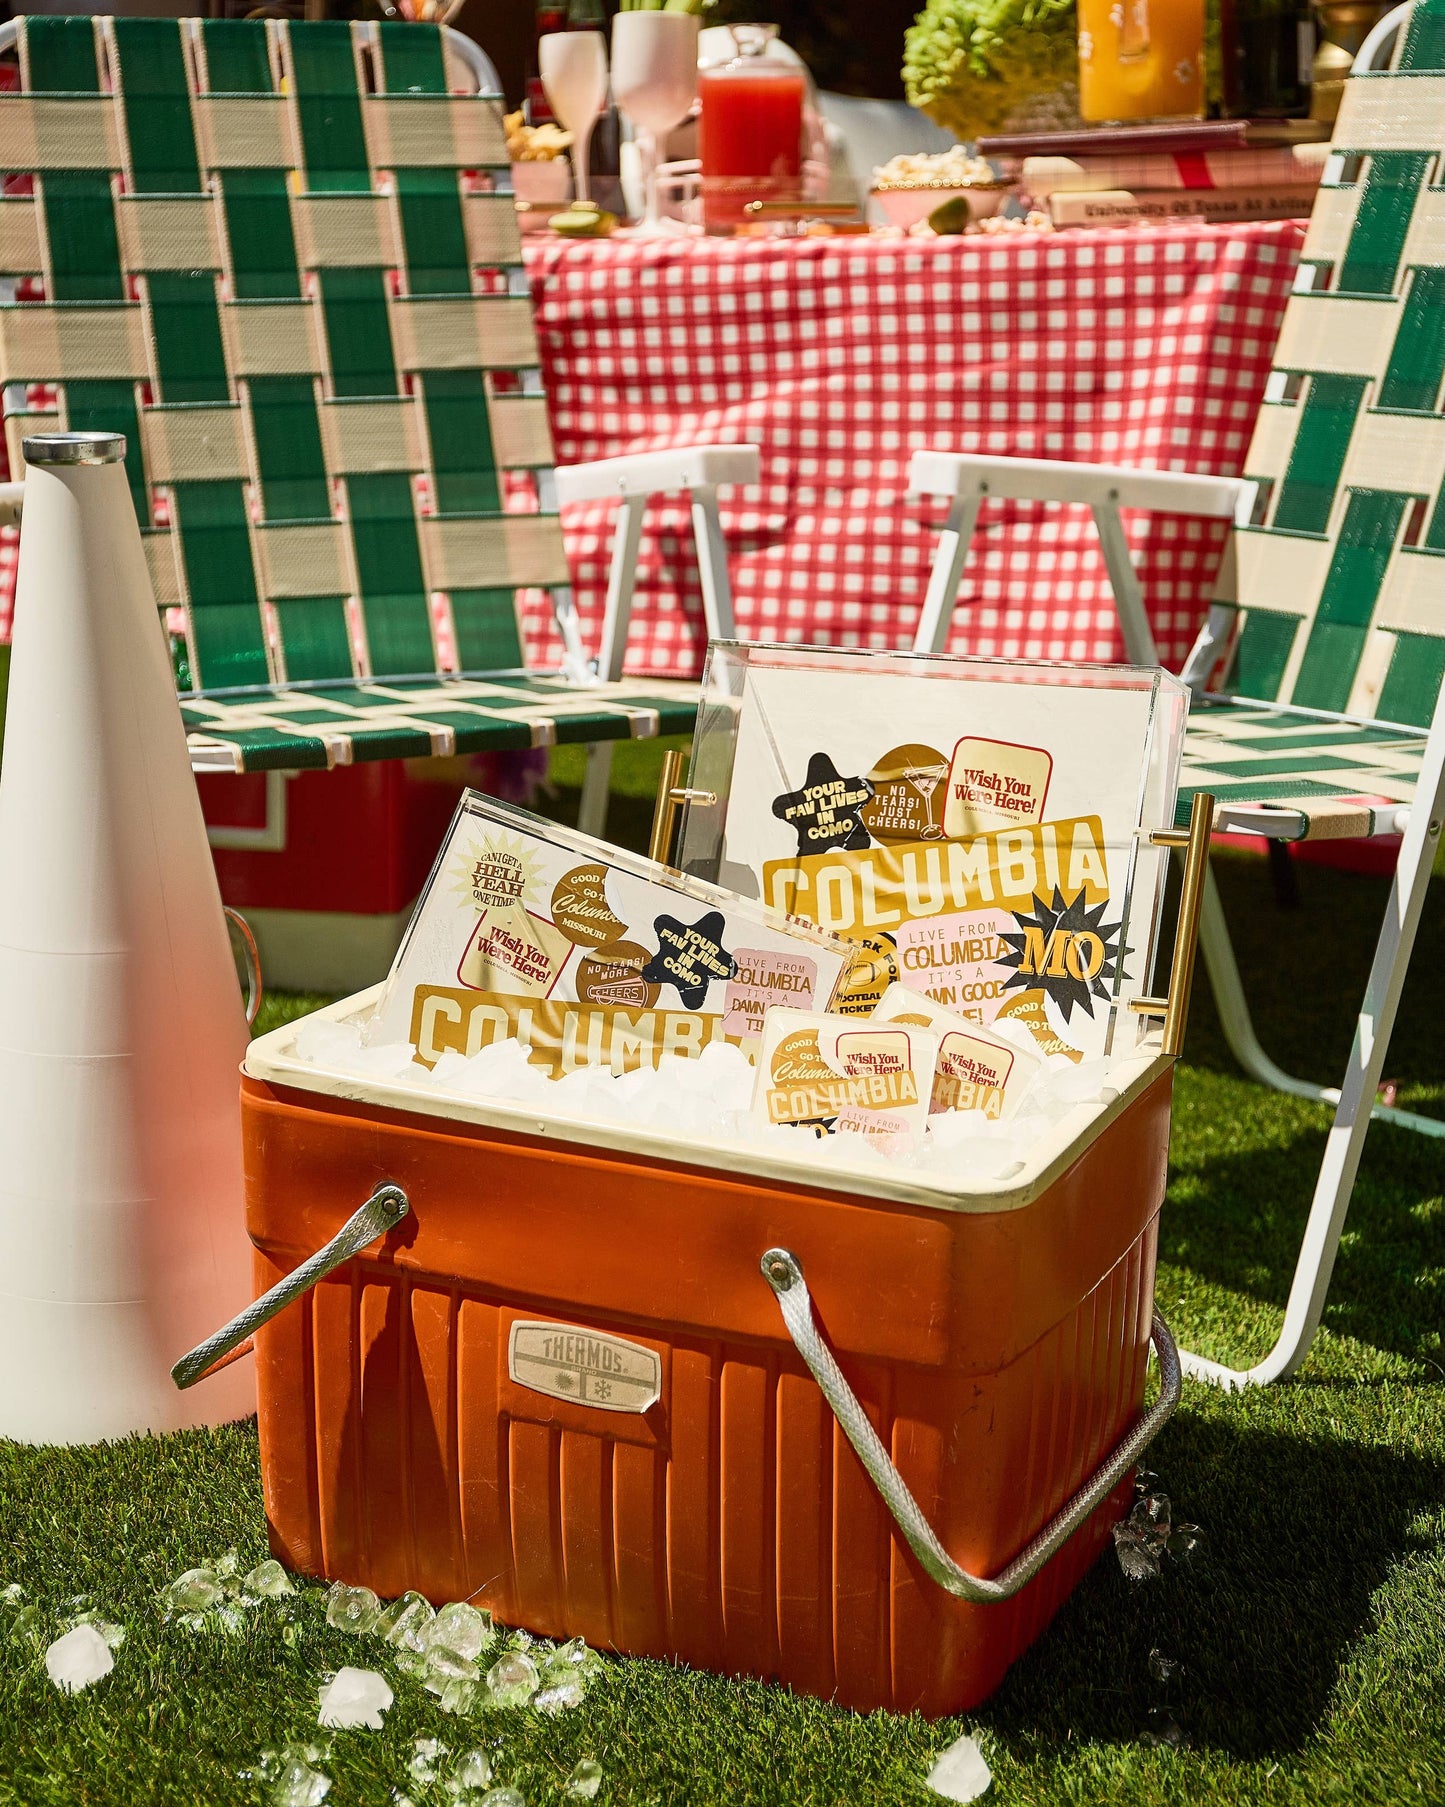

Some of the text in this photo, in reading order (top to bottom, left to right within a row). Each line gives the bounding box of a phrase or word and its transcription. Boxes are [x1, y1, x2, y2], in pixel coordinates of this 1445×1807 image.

[802, 780, 846, 802] YOUR
[889, 785, 906, 796] NO
[964, 769, 1031, 797] Wish You
[785, 789, 869, 820] FAV LIVES
[875, 794, 920, 809] TEARS!
[954, 784, 1037, 814] Were Here!
[816, 809, 835, 825] IN
[879, 806, 912, 819] JUST
[807, 818, 854, 840] COMO
[868, 815, 921, 830] CHEERS!
[474, 861, 526, 884] HELL
[516, 862, 522, 870] A
[471, 874, 525, 897] YEAH
[570, 874, 600, 884] GOOD
[772, 822, 1108, 931] COLUMBIA
[472, 889, 516, 907] ONE TIME
[583, 888, 597, 898] GO
[561, 917, 607, 941] MISSOURI
[909, 921, 997, 944] LIVE FROM
[489, 926, 551, 968] Wish You
[660, 928, 730, 976] FAV LIVES
[684, 928, 720, 957] YOUR
[860, 939, 883, 953] RK
[477, 936, 551, 984] Were Here!
[677, 952, 696, 967] IN
[903, 936, 1010, 972] COLUMBIA
[1018, 925, 1106, 982] MO
[587, 956, 645, 975] NO TEARS!
[600, 968, 629, 980] MORE
[663, 957, 701, 985] COMO
[739, 957, 805, 973] LIVE FROM
[732, 967, 812, 994] COLUMBIA
[928, 967, 984, 985] IT'S A
[595, 987, 639, 999] CHEERS
[747, 989, 788, 1002] IT'S A
[961, 980, 1007, 1002] GOOD
[733, 998, 765, 1015] DAMN
[1006, 1002, 1039, 1018] GOOD
[785, 1039, 813, 1052] GOOD
[800, 1052, 814, 1061] GO
[847, 1053, 899, 1065] Wish You
[949, 1052, 997, 1078] Wish You
[843, 1063, 905, 1075] Were Here!
[770, 1073, 918, 1119] COLUMBIA
[847, 1111, 869, 1123] LIVE
[877, 1119, 900, 1130] FROM
[542, 1336, 622, 1374] THERMOS
[570, 1365, 598, 1376] BRAND
